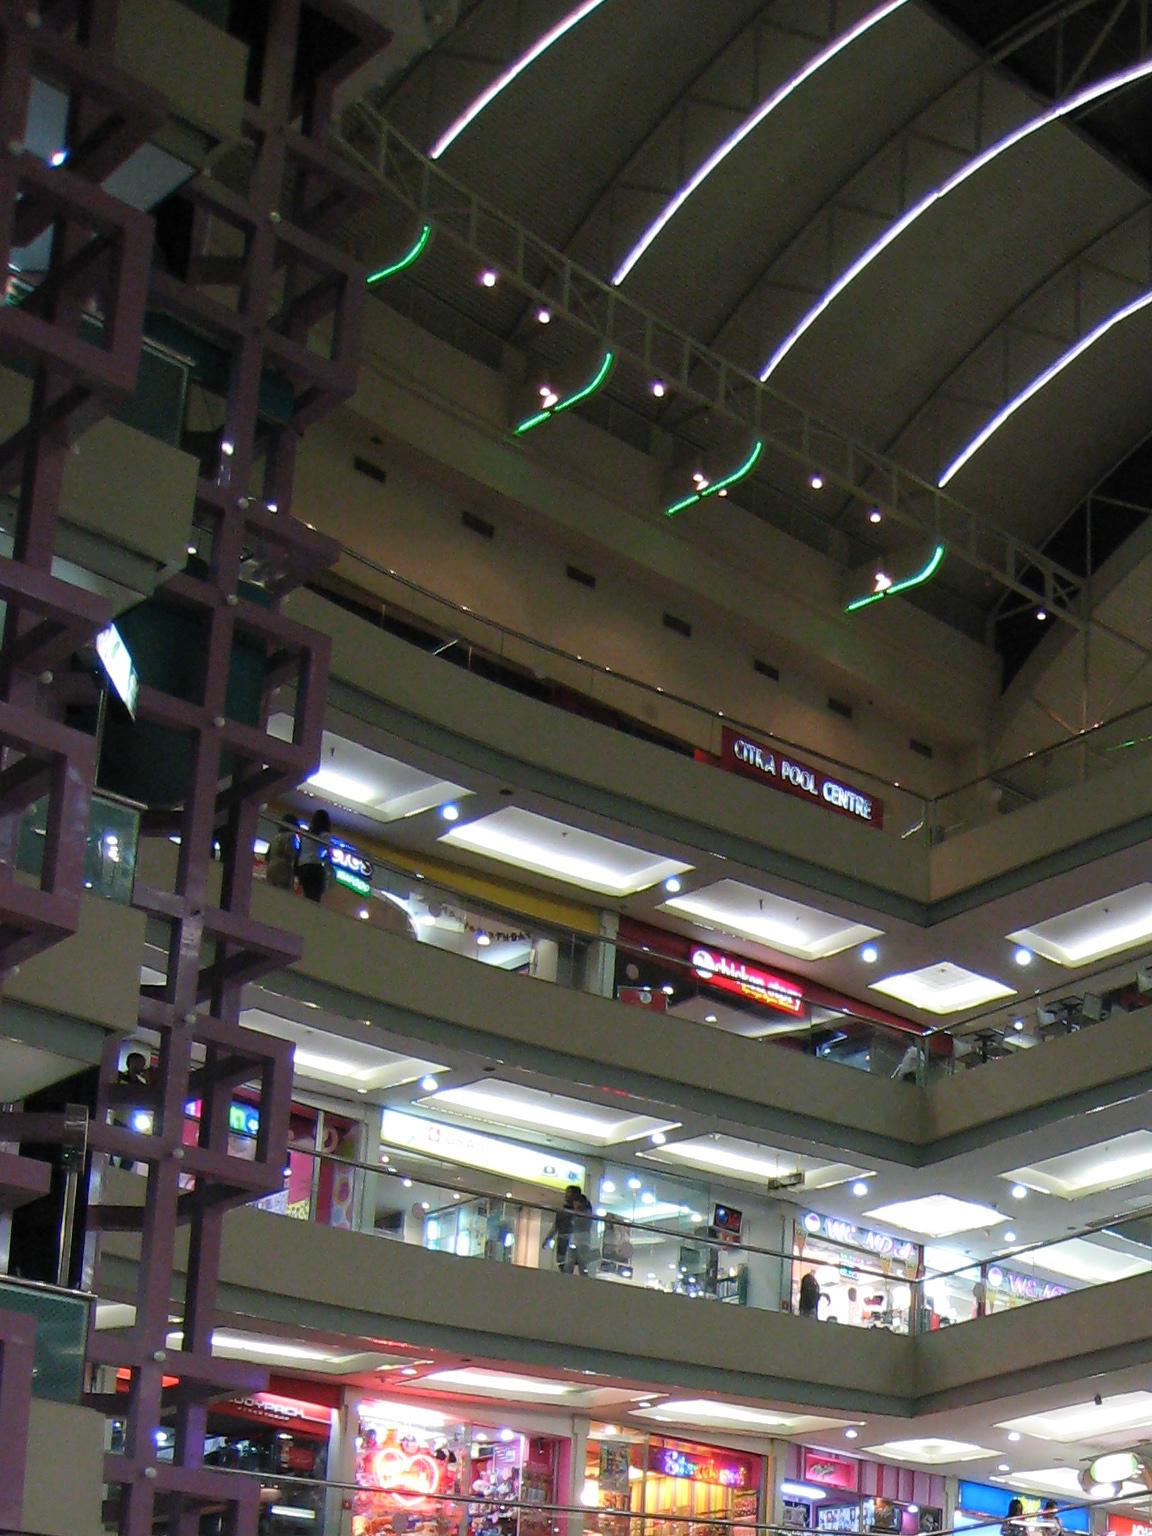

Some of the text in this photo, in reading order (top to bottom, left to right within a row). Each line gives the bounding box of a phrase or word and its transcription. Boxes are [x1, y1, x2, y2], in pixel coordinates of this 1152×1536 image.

[734, 740, 872, 820] CITRA POOL CENTRE
